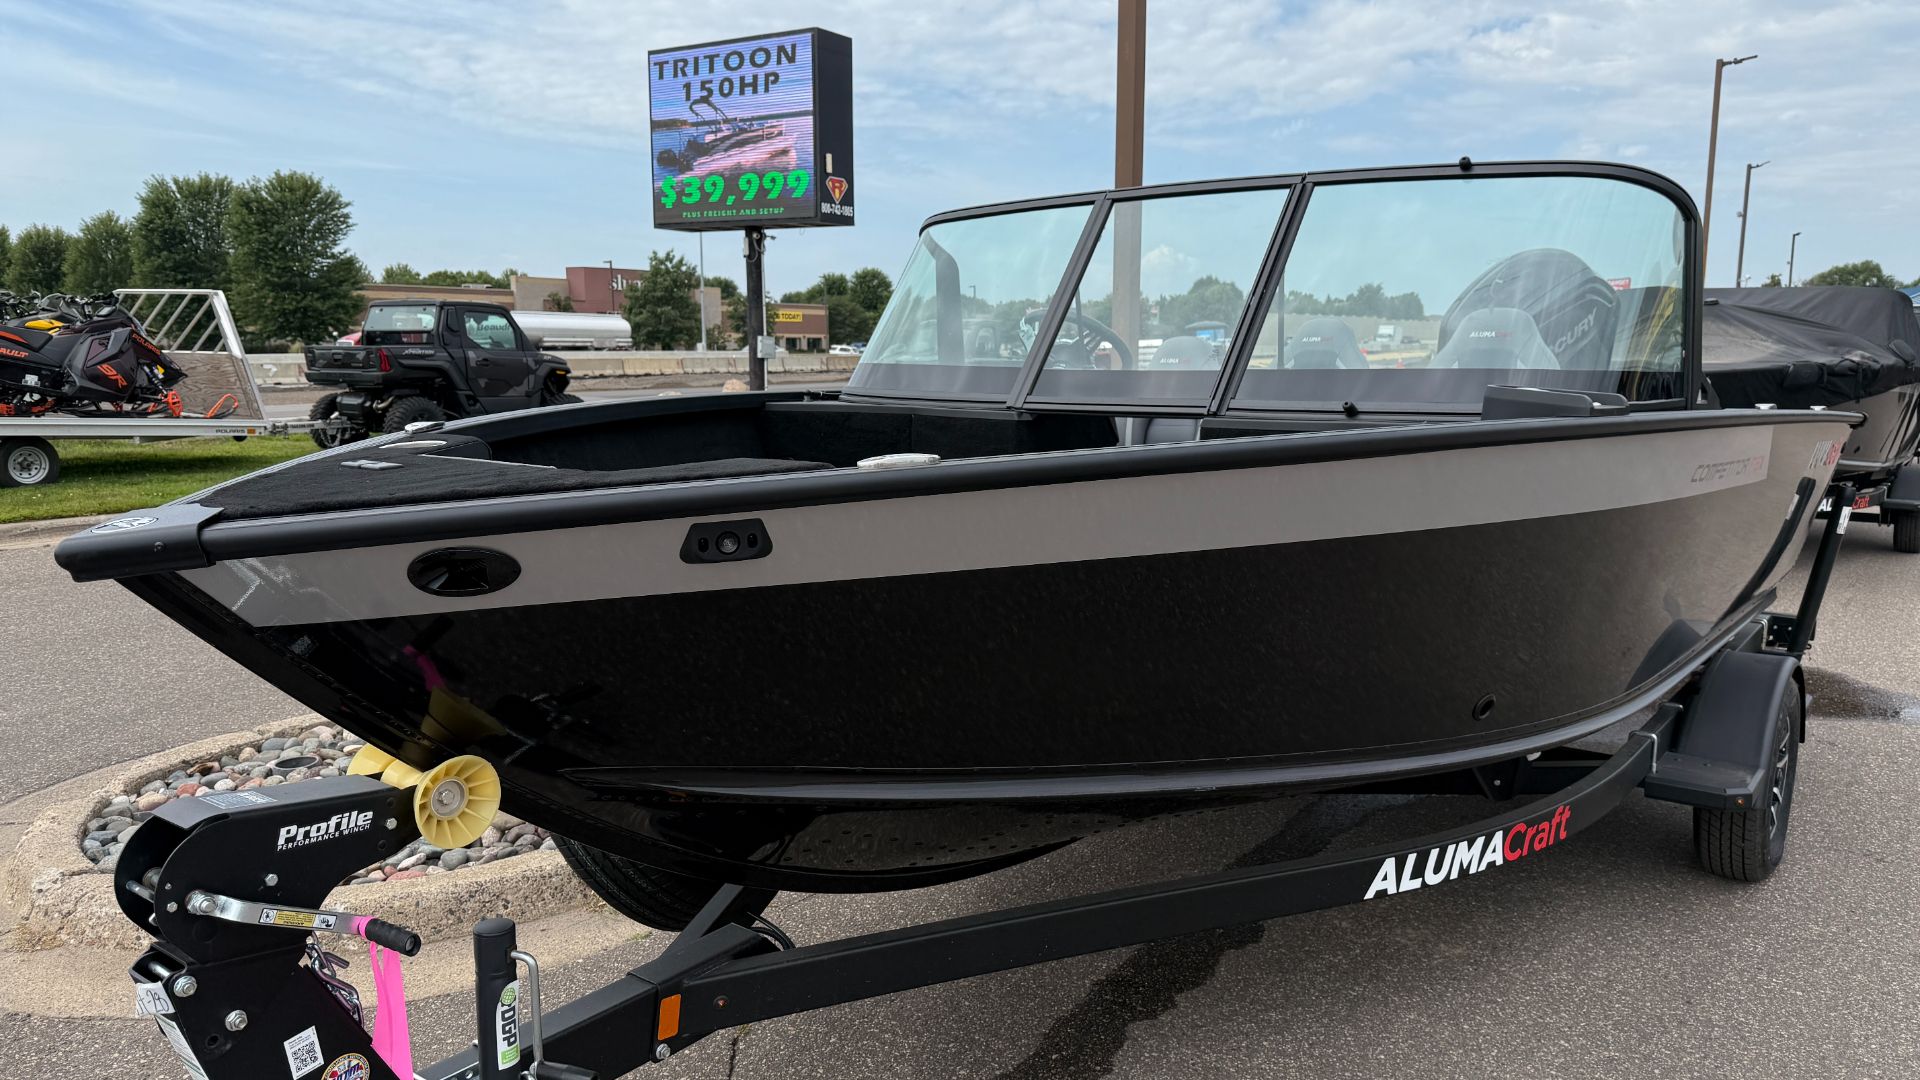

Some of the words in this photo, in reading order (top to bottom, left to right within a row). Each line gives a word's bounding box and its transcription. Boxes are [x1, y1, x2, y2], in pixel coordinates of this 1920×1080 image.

[653, 43, 797, 80] TRITOON
[682, 71, 780, 101] 150HP
[661, 169, 810, 208] $39,999
[703, 209, 737, 217] FREIGHT
[739, 208, 757, 216] AND
[759, 207, 785, 215] SETUP
[132, 333, 161, 356] POLARIS
[1554, 306, 1597, 353] CURY
[97, 363, 128, 389] 9R
[277, 810, 374, 846] Profile
[277, 831, 340, 852] PERFORMANCE
[342, 823, 371, 836] WINCH
[1363, 804, 1571, 900] ALUMACraft
[500, 1004, 518, 1048] DGP
